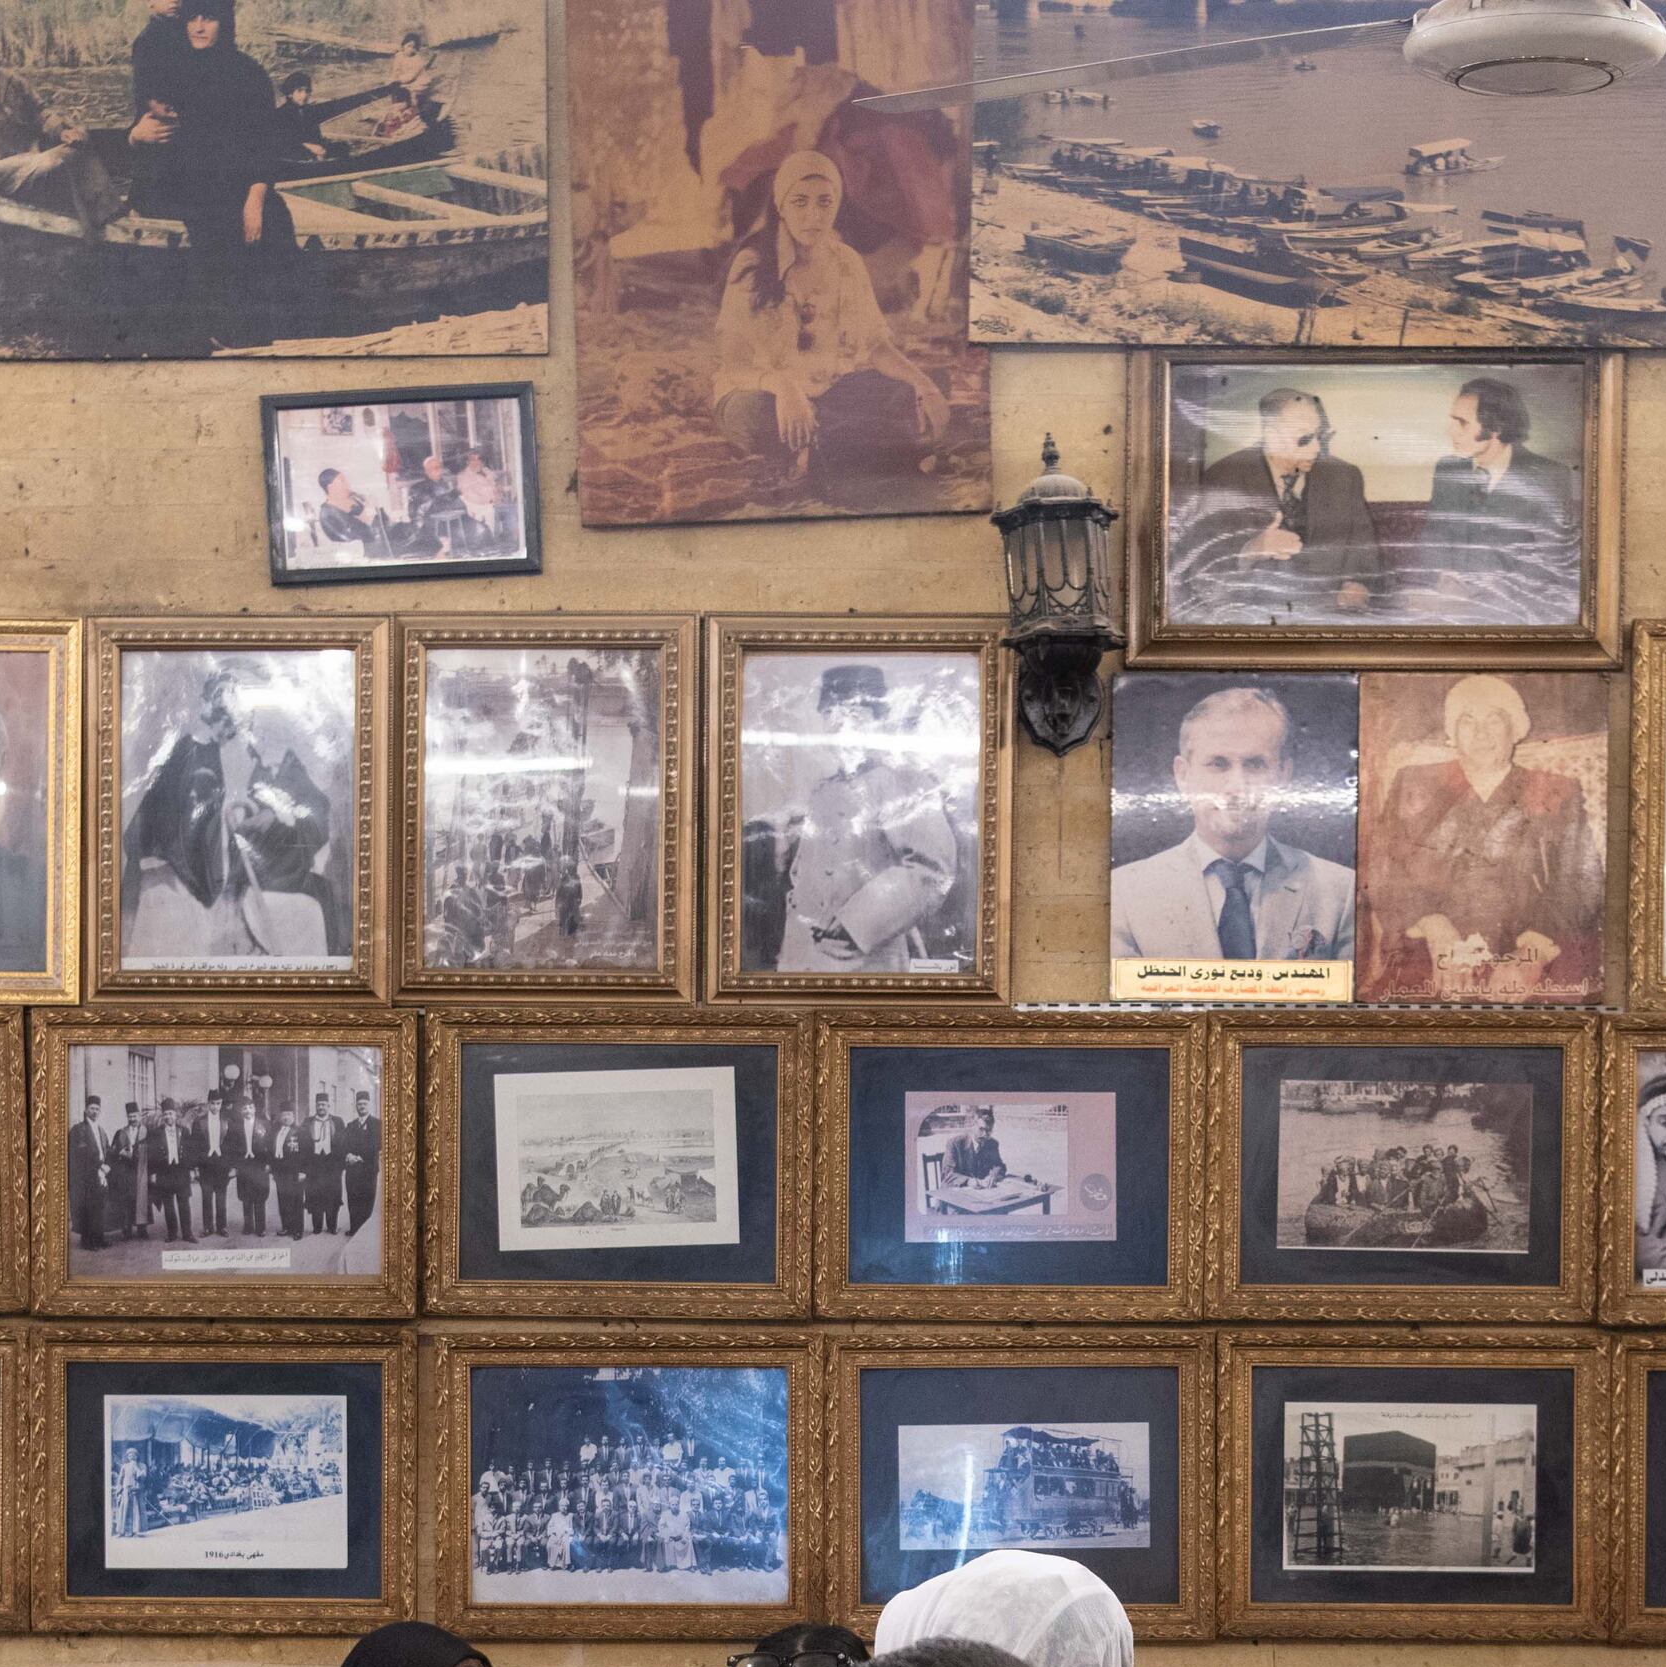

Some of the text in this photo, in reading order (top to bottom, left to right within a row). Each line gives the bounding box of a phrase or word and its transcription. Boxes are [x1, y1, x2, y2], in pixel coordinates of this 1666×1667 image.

[1137, 964, 1186, 980] الحنظل
[1190, 965, 1226, 984] نوري
[1229, 967, 1263, 982] وديع
